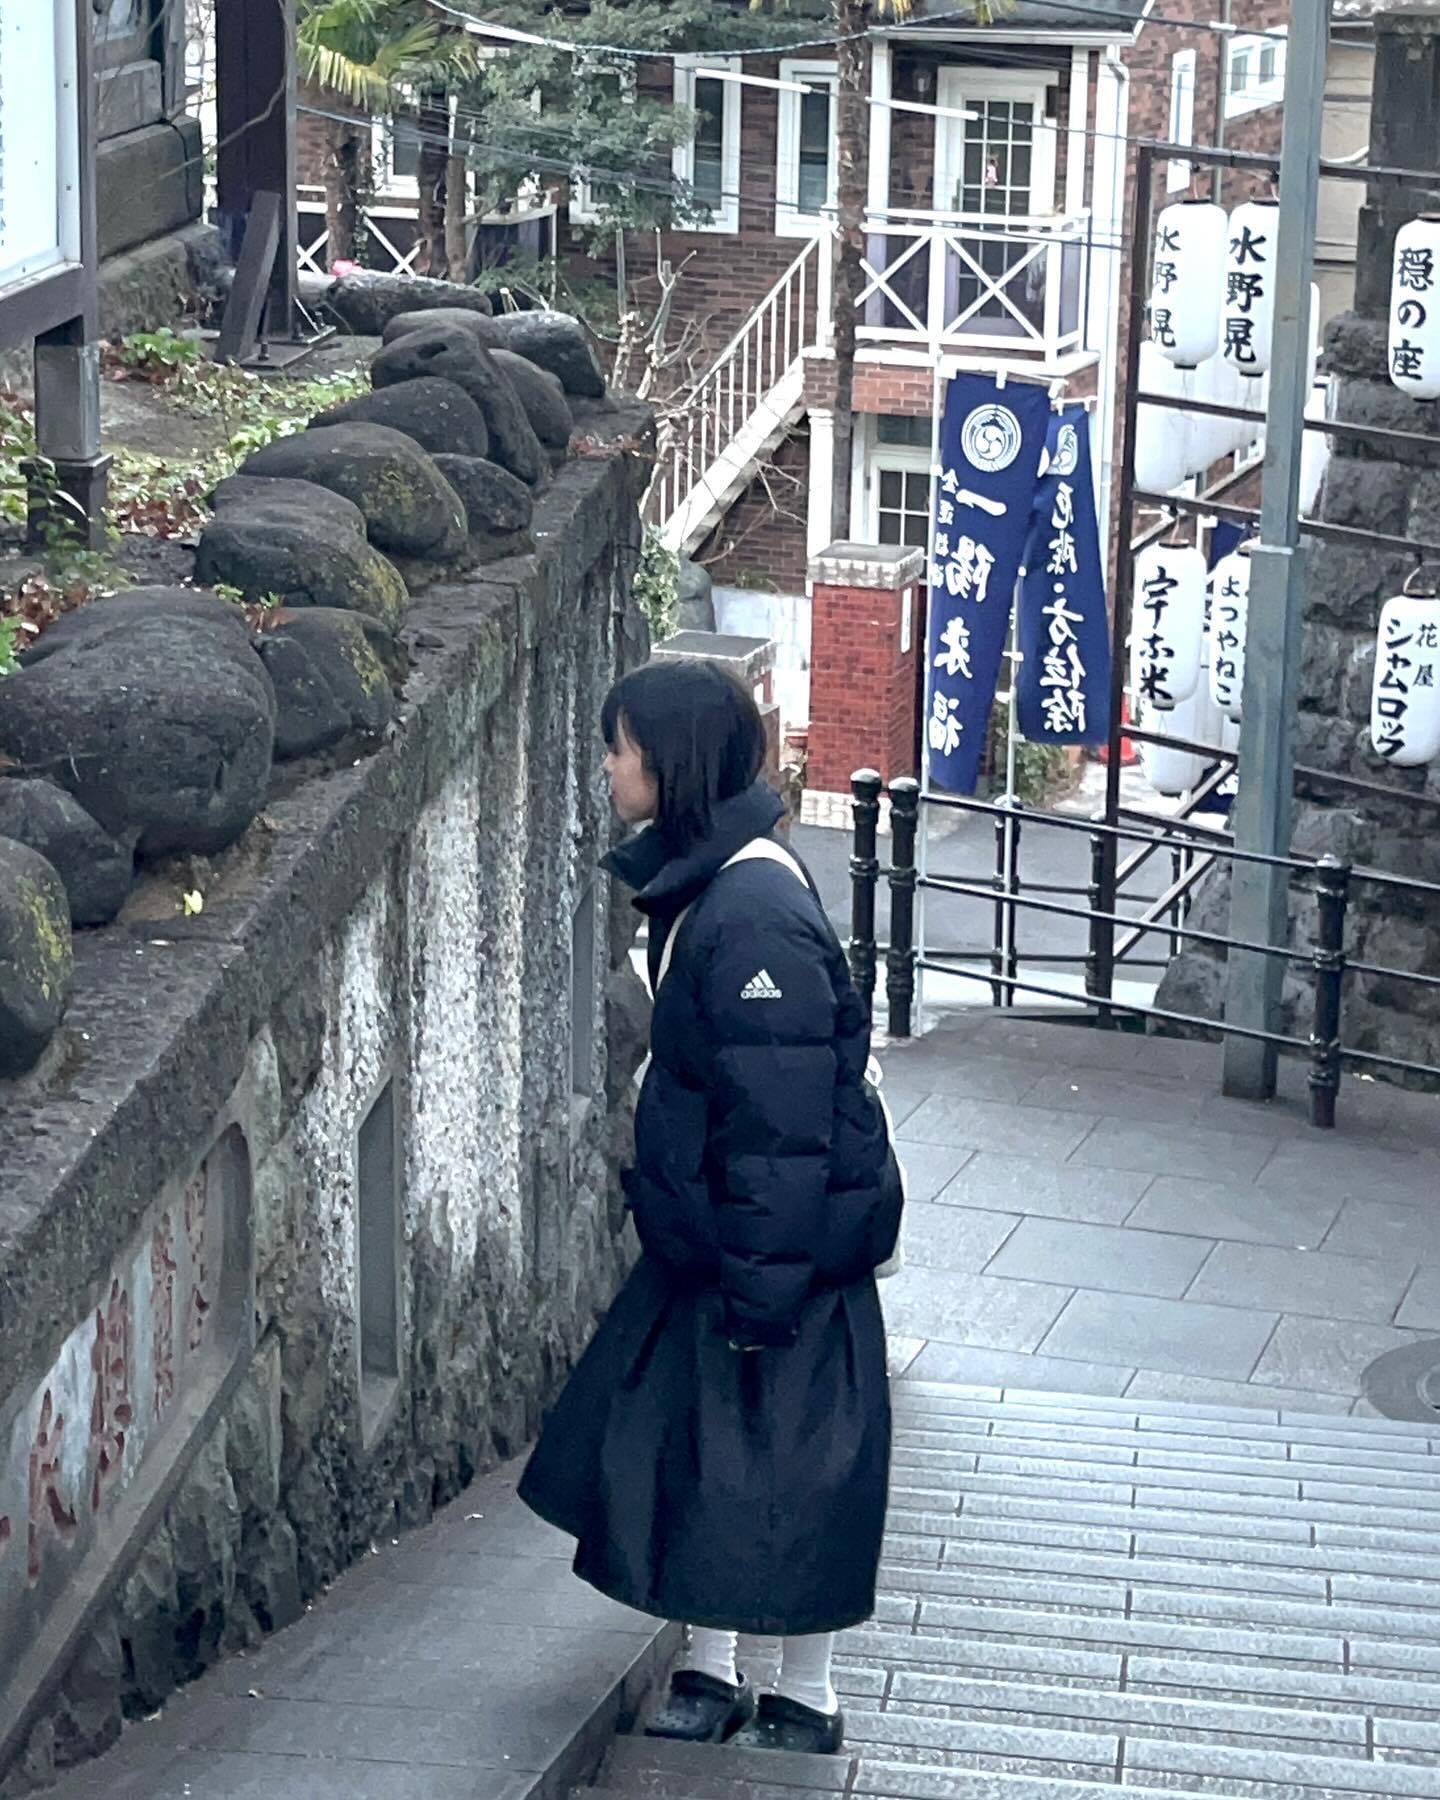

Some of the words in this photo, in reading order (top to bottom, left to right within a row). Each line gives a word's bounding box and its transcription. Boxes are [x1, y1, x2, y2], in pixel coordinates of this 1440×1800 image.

[1223, 225, 1267, 364] 水野晃
[1216, 575, 1240, 706] よつやねこ
[1376, 617, 1414, 757] シャムロック
[1413, 622, 1439, 688] 花屋
